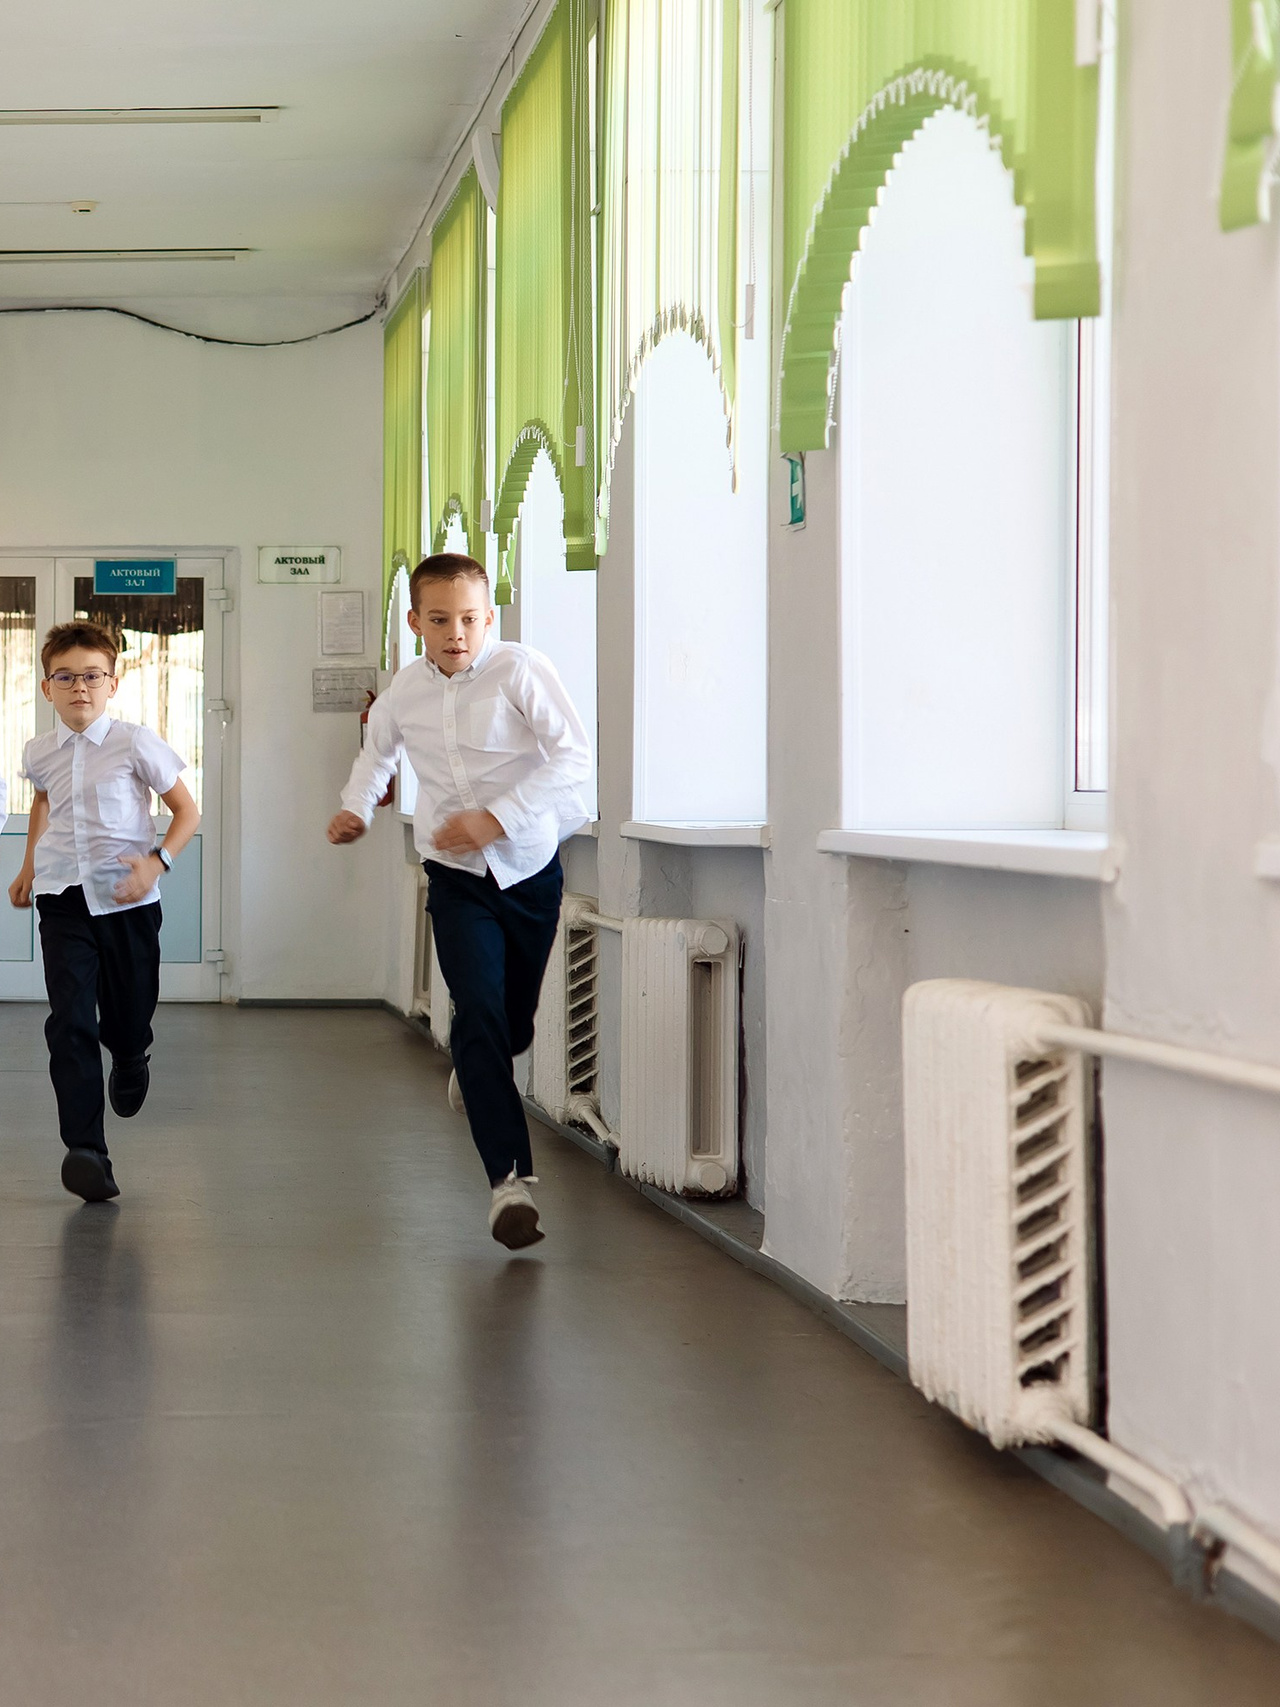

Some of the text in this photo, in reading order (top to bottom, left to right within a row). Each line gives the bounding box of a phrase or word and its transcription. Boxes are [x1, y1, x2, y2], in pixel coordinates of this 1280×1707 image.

[273, 554, 326, 565] АКТОВЫЙ
[109, 567, 161, 577] АКТОВЫЙ
[289, 567, 310, 576] ЗАЛ
[124, 579, 146, 587] ЗАЛ
